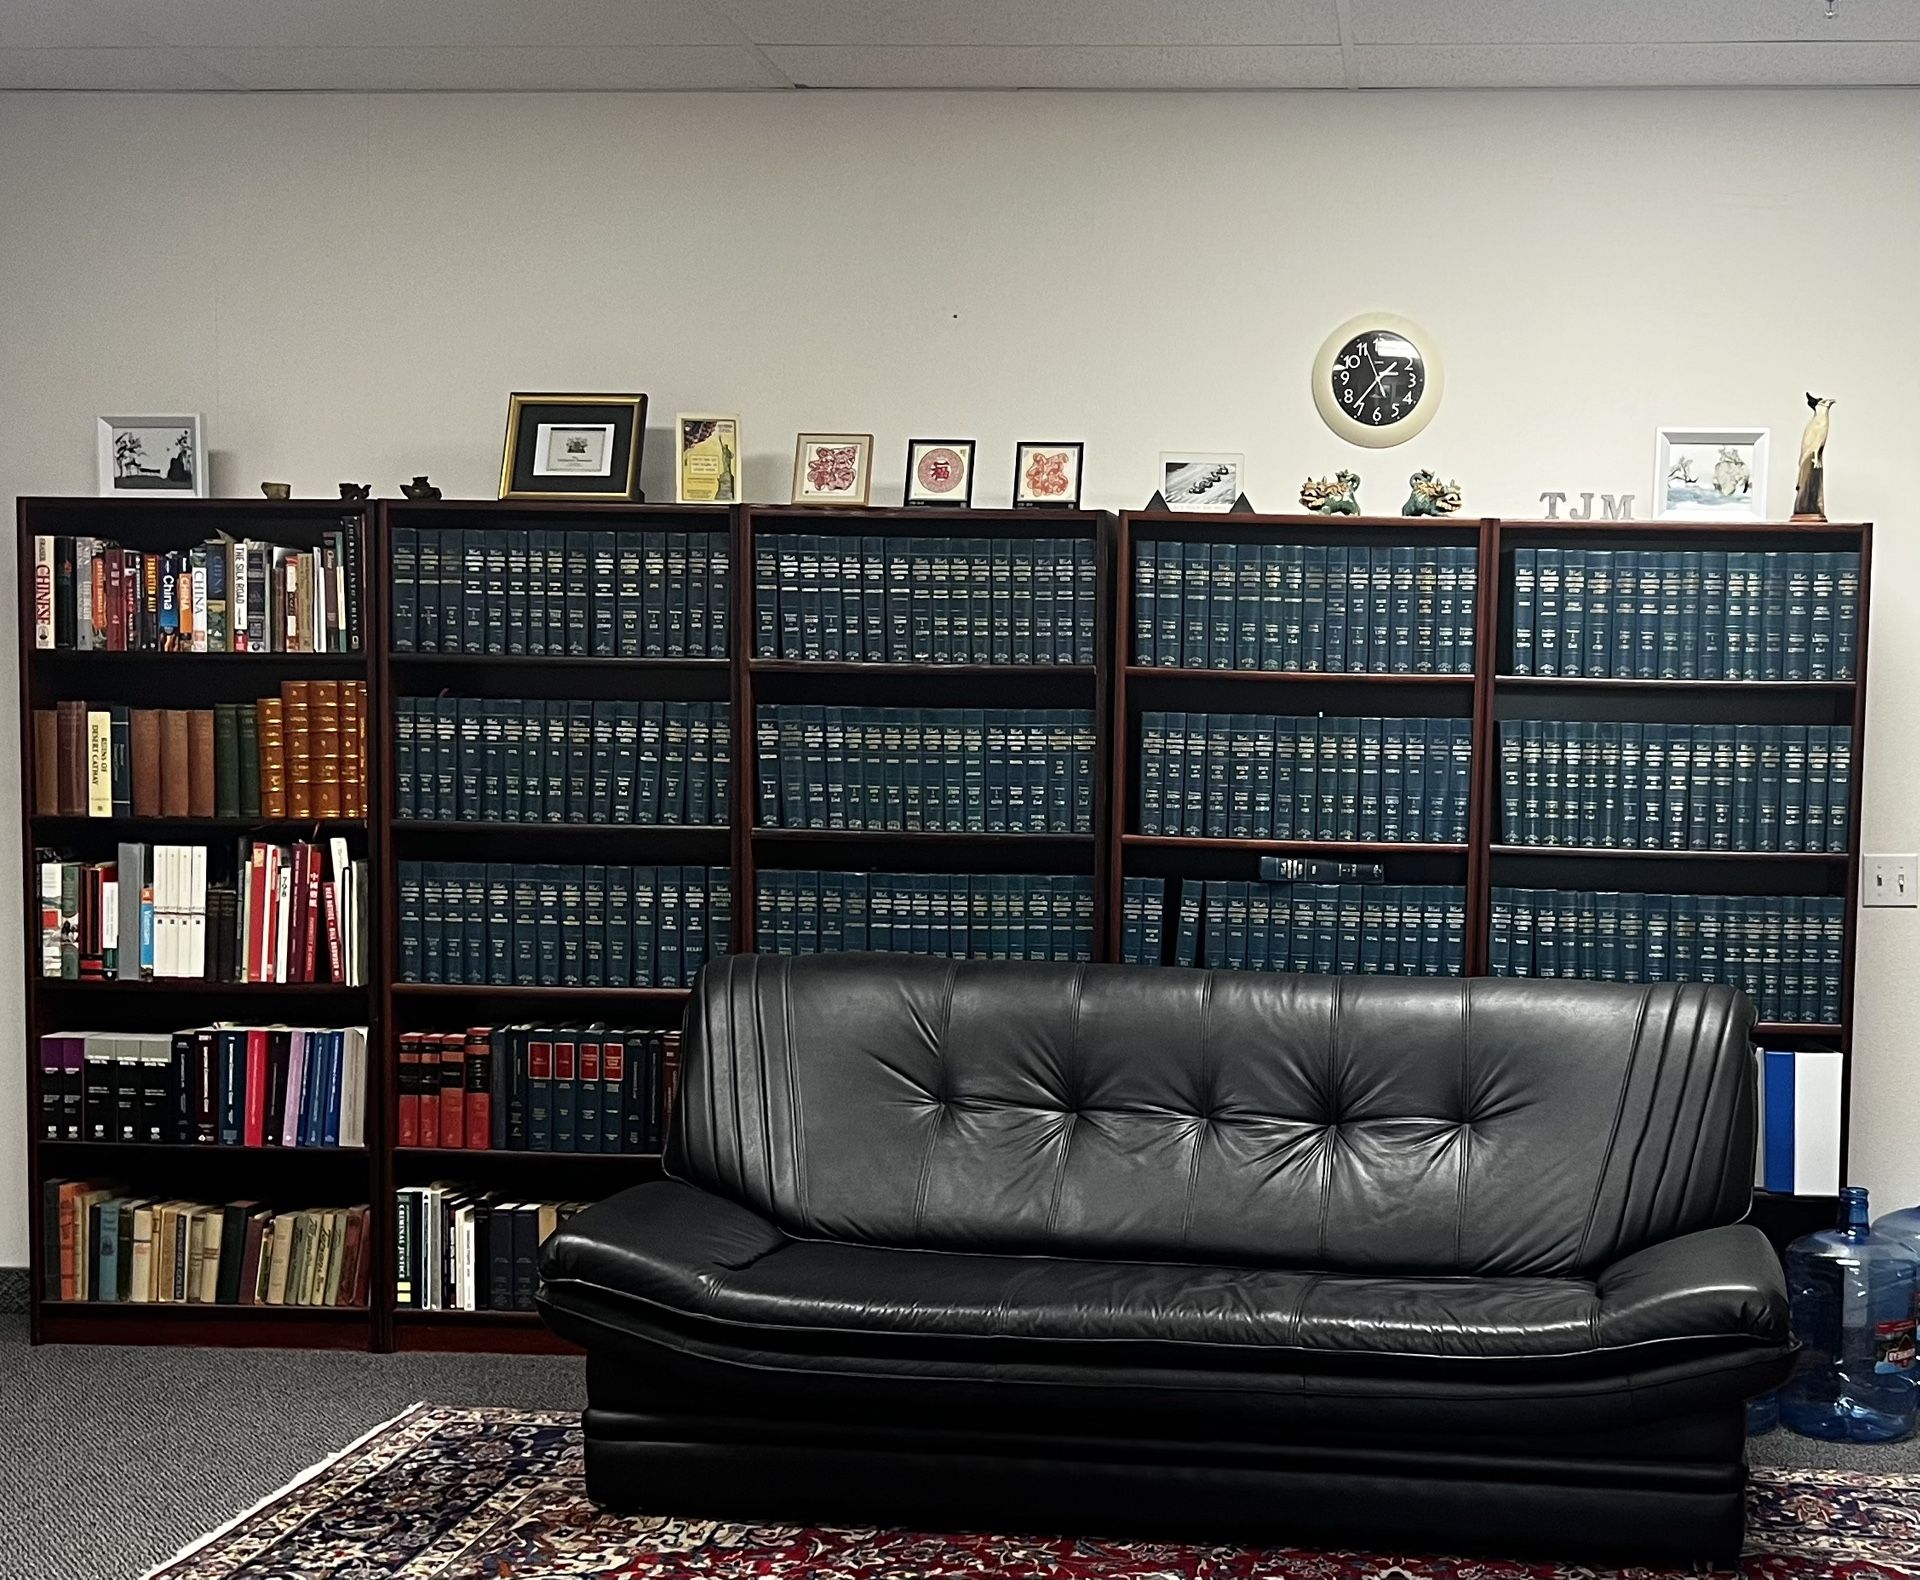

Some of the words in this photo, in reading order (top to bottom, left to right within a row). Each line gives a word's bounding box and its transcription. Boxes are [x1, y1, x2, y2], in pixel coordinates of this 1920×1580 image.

[1357, 342, 1368, 356] 11
[1344, 355, 1360, 369] 10
[1404, 356, 1413, 370] 2
[1340, 371, 1349, 385] 9
[1408, 373, 1416, 388] 3
[1344, 389, 1353, 403] 8
[1402, 391, 1413, 405] 4
[1357, 401, 1364, 416] 7
[1372, 406, 1381, 421] 6
[1391, 403, 1399, 417] 5
[1539, 492, 1635, 520] TJM
[235, 547, 245, 562] THE
[213, 555, 223, 594] CHINA
[237, 563, 245, 581] SILK
[36, 564, 51, 626] CHINESE
[163, 574, 174, 610] China
[181, 576, 190, 611] CHINA
[194, 570, 205, 614] CHINA
[237, 583, 246, 605] ROAD
[398, 1204, 406, 1245] CRIMINAL
[398, 1246, 406, 1279] JUSTICE
